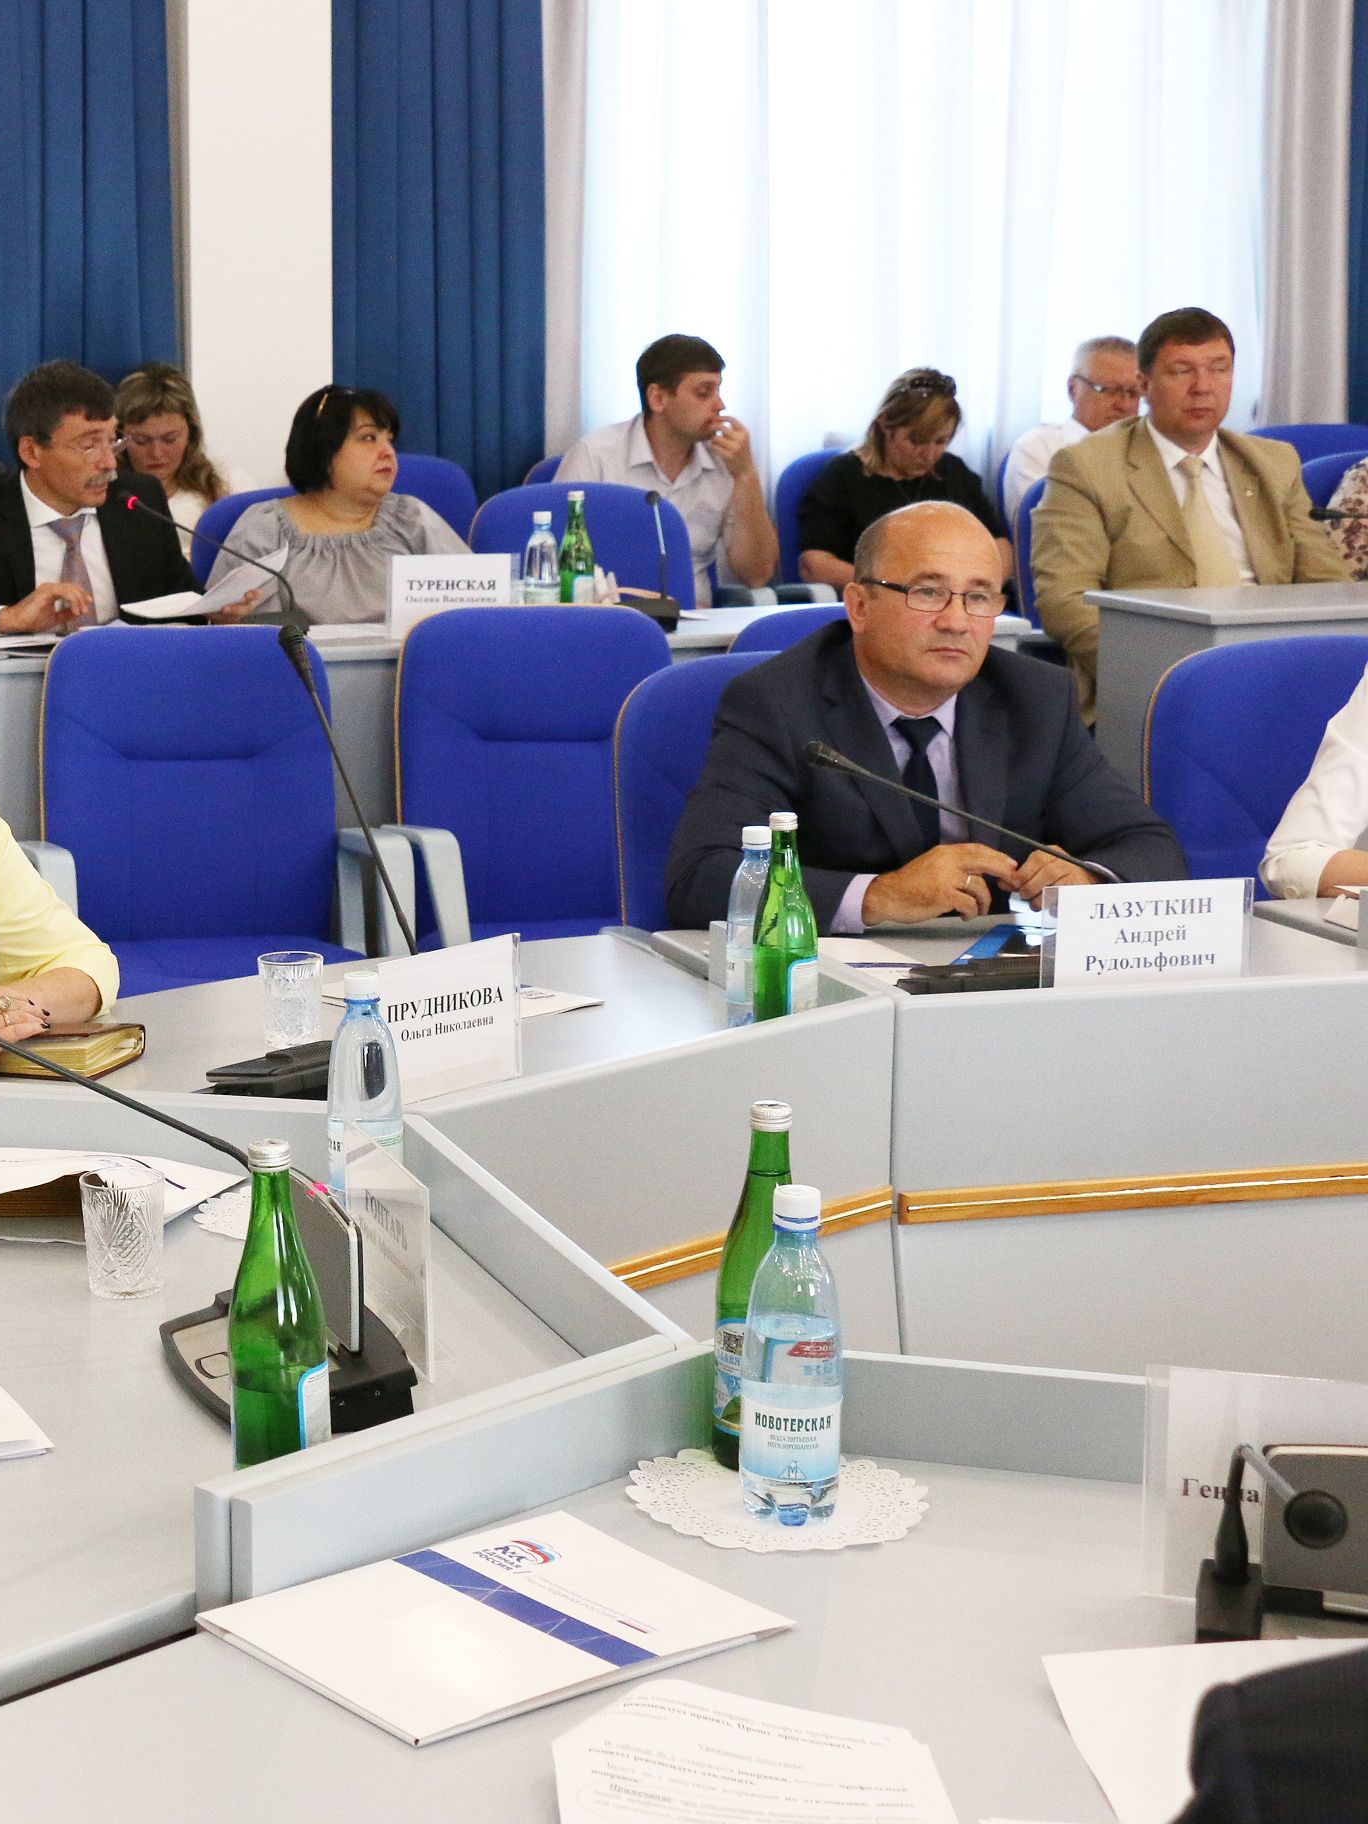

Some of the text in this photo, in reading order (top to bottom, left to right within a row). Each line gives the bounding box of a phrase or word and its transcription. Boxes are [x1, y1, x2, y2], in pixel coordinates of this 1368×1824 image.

[407, 579, 497, 591] ТУРЕНСКАЯ
[1089, 897, 1213, 920] ЛАЗУТКИН
[1114, 925, 1187, 947] Андрей
[1085, 952, 1216, 975] Рудольфович
[387, 986, 504, 1024] ПРУДНИКОВА
[400, 1015, 495, 1042] Ольга Николаевна
[755, 1412, 832, 1432] НОВОТЕРСКАЯ
